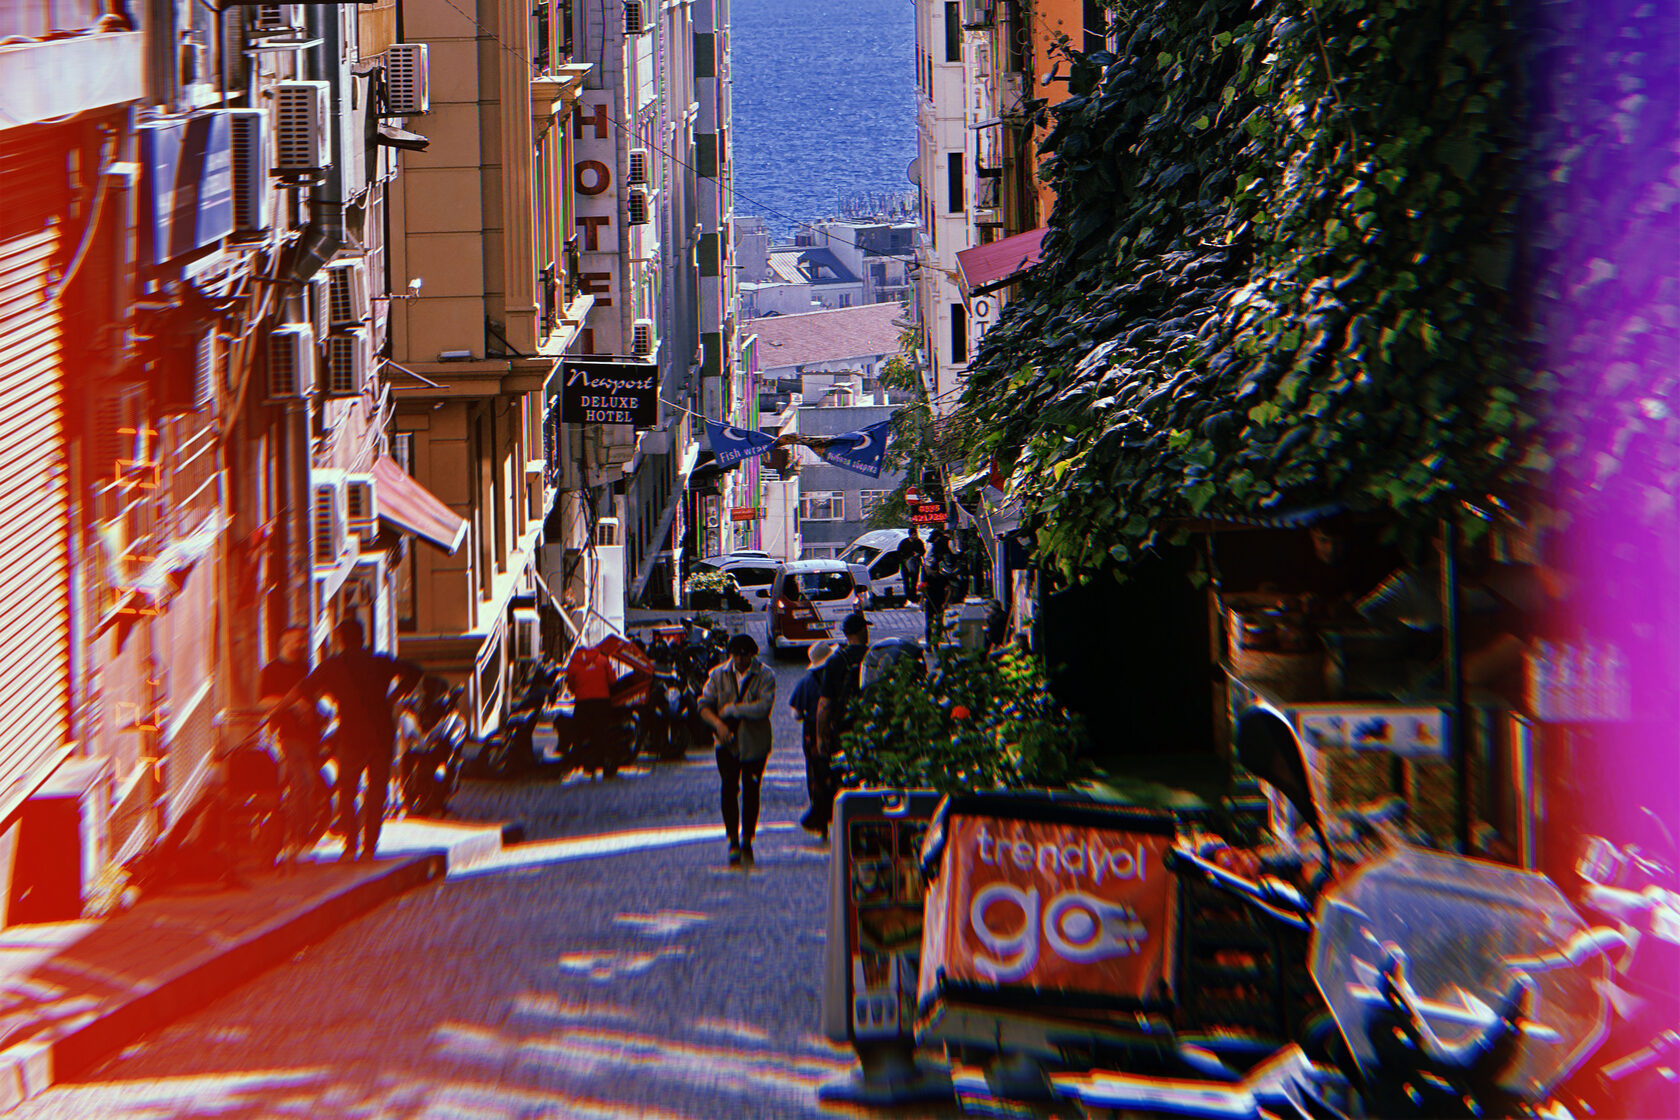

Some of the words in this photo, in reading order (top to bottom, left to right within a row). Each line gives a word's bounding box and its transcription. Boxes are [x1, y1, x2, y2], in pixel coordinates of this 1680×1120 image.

[573, 104, 613, 363] HOTEL
[566, 368, 654, 395] Newport
[580, 395, 640, 409] DELUXE
[585, 409, 633, 423] HOTEL
[719, 447, 742, 463] Fish
[976, 824, 1146, 882] trendyol
[970, 880, 1148, 981] go
